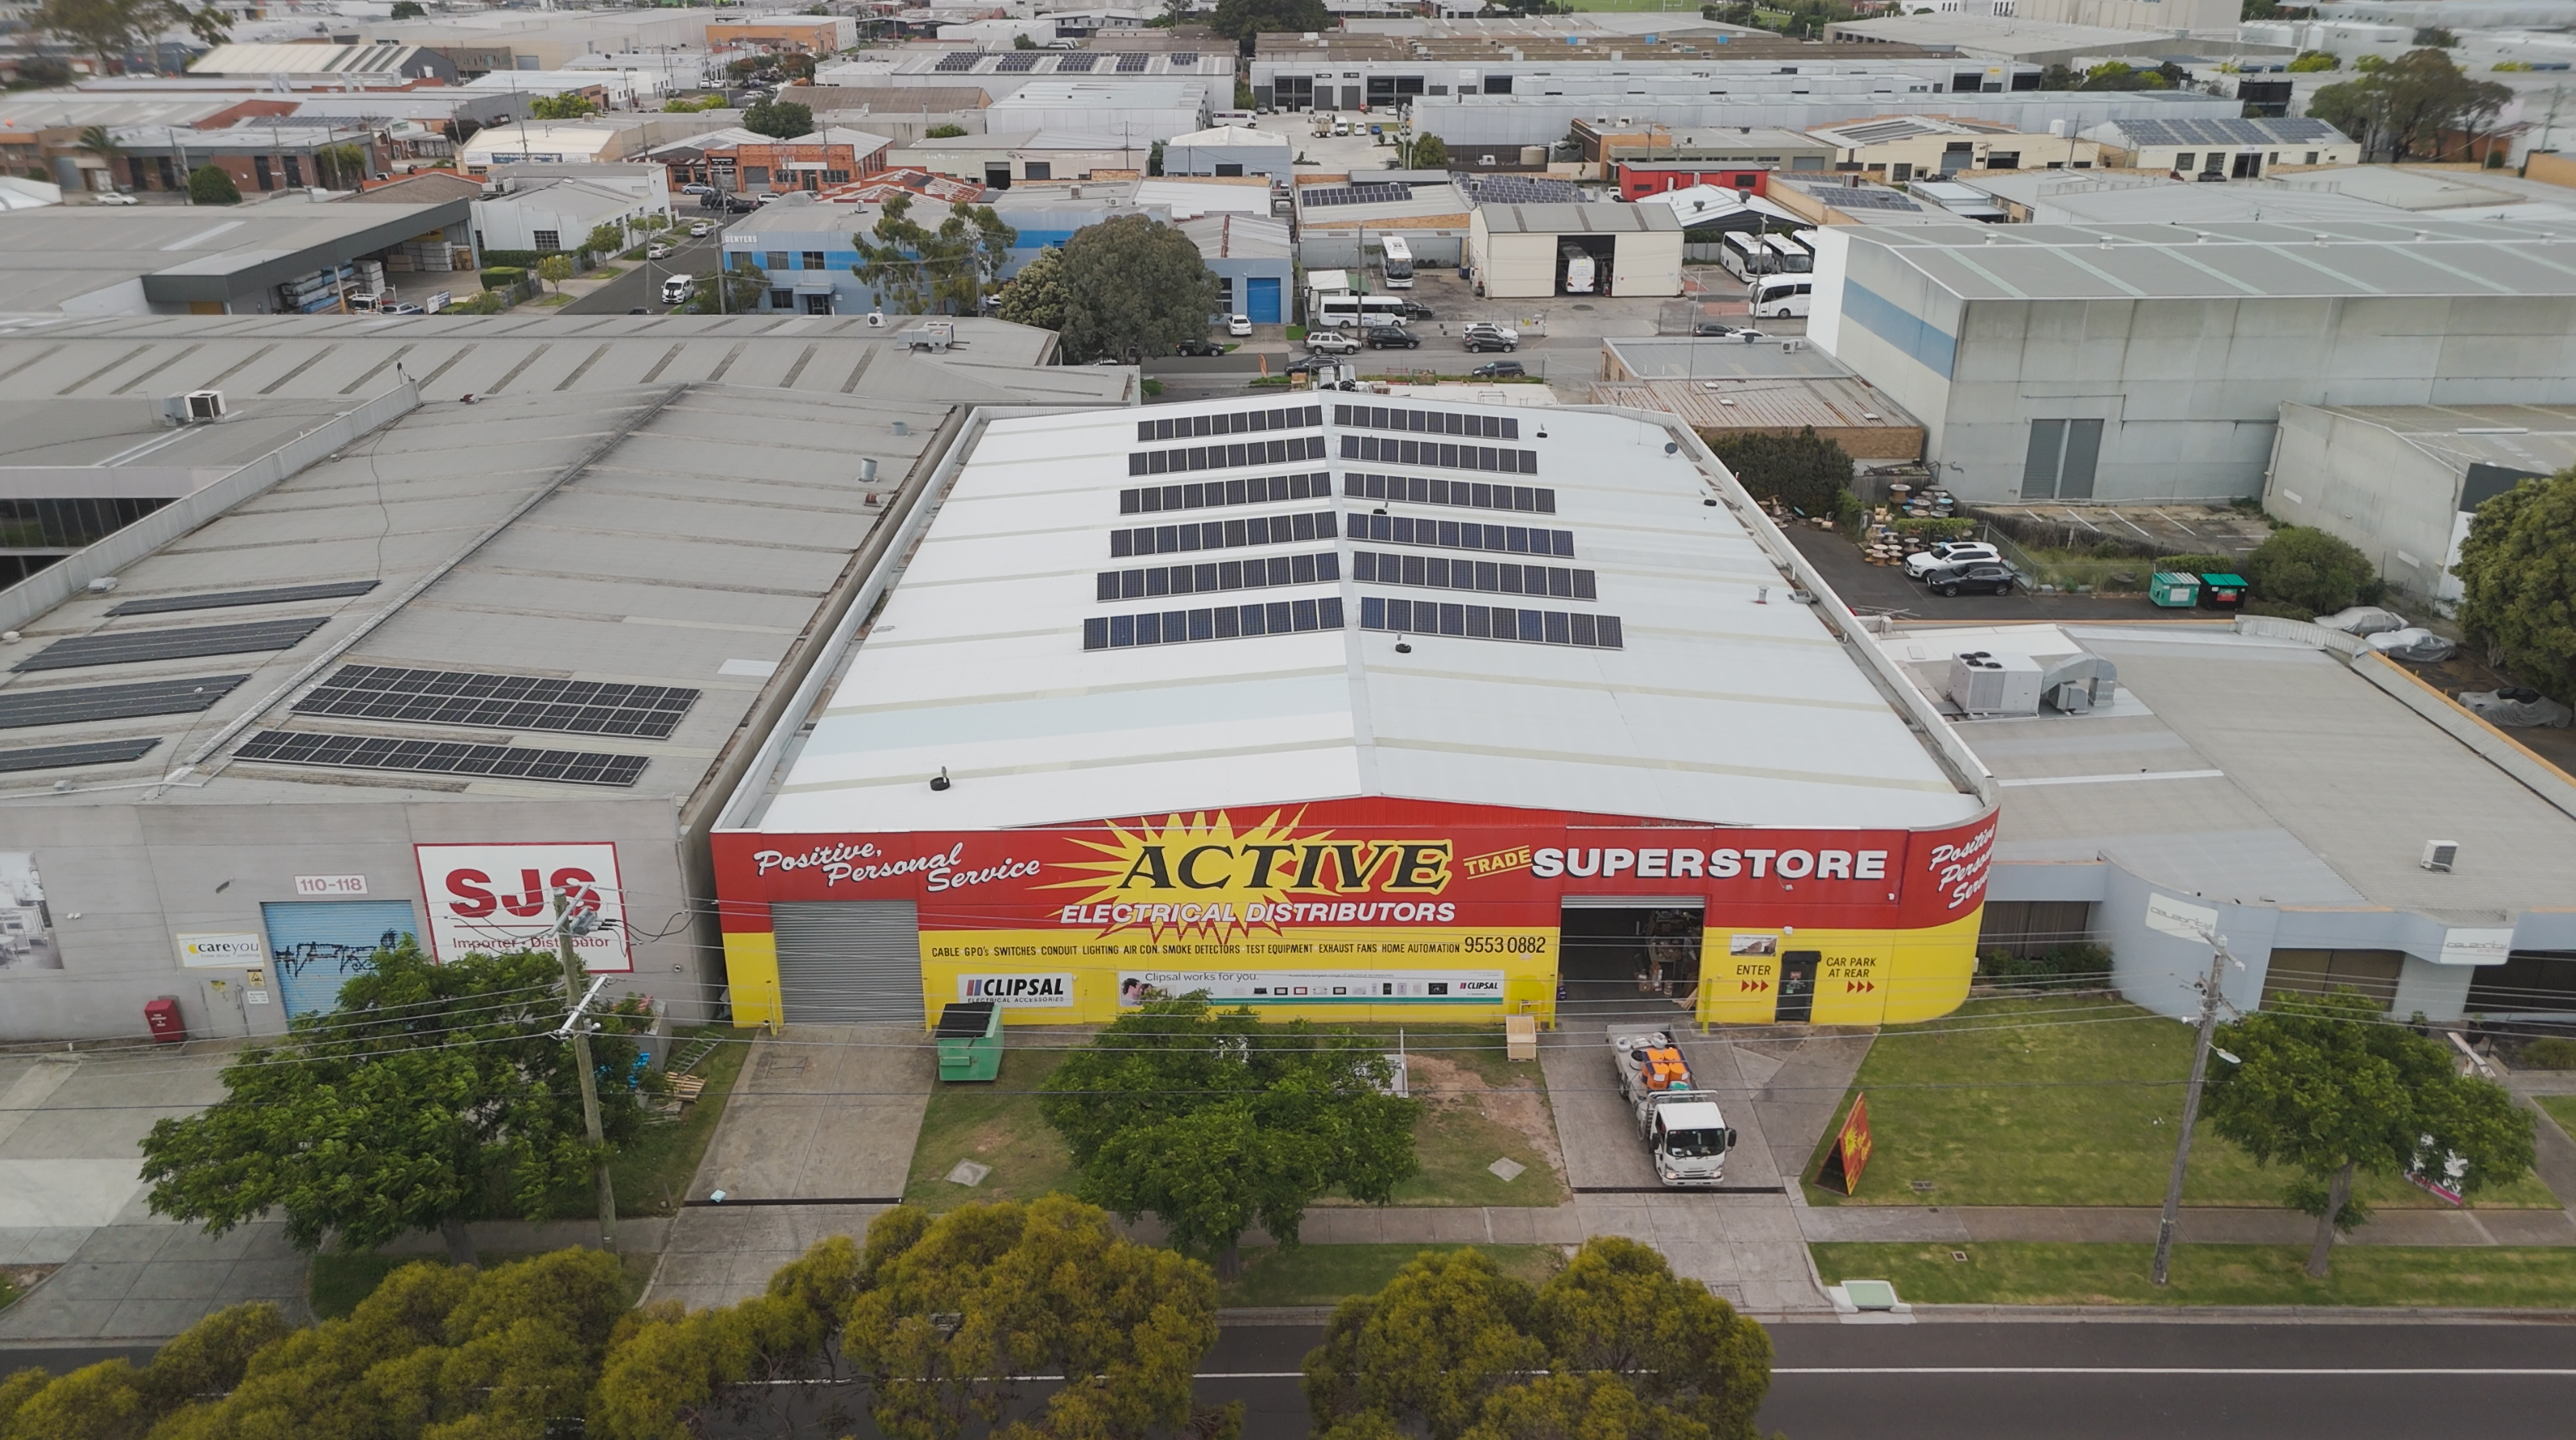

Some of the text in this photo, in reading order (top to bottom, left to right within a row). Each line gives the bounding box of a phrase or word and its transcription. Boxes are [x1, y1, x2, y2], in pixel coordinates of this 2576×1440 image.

[725, 235, 757, 243] DENYERS
[753, 842, 882, 876] Positive,
[823, 842, 963, 888] Personal
[1116, 843, 1449, 890] ACTIVE
[1464, 847, 1889, 879] TRADE SUPERSTORE
[927, 858, 1041, 892] Service
[300, 878, 362, 892] 110-118
[445, 867, 602, 918] SJS
[1059, 902, 1456, 925] ELECTRICAL DISTRIBUTORS
[453, 937, 516, 951] Importer
[932, 947, 959, 957] CABLE
[964, 946, 989, 957] GPO's
[994, 946, 1037, 956] SWITCHES
[1042, 946, 1077, 956] CONDUIT
[1083, 946, 1119, 955] LIGHTING
[1124, 945, 1137, 954] AIR
[1162, 945, 1191, 954] SMOKE
[1195, 944, 1240, 954] DETECTORS
[1245, 944, 1265, 954] TEST
[1268, 944, 1313, 954] EQUIPMENT
[1319, 944, 1354, 954] EXHAUST
[1357, 944, 1377, 953] FANS
[1381, 943, 1405, 954] HOME
[1407, 943, 1460, 954] AUTOMATION
[1464, 937, 1504, 954] 9553
[1507, 937, 1546, 954] 0882
[1737, 965, 1771, 975] ENTER
[1826, 958, 1877, 966] CAR PARK
[1145, 972, 1182, 983] Clipsal
[1184, 972, 1216, 982] works
[1219, 972, 1233, 981] for
[1828, 969, 1870, 978] AT REAR
[984, 979, 1064, 996] CLIPSAL
[1468, 982, 1498, 990] CLIPSAL
